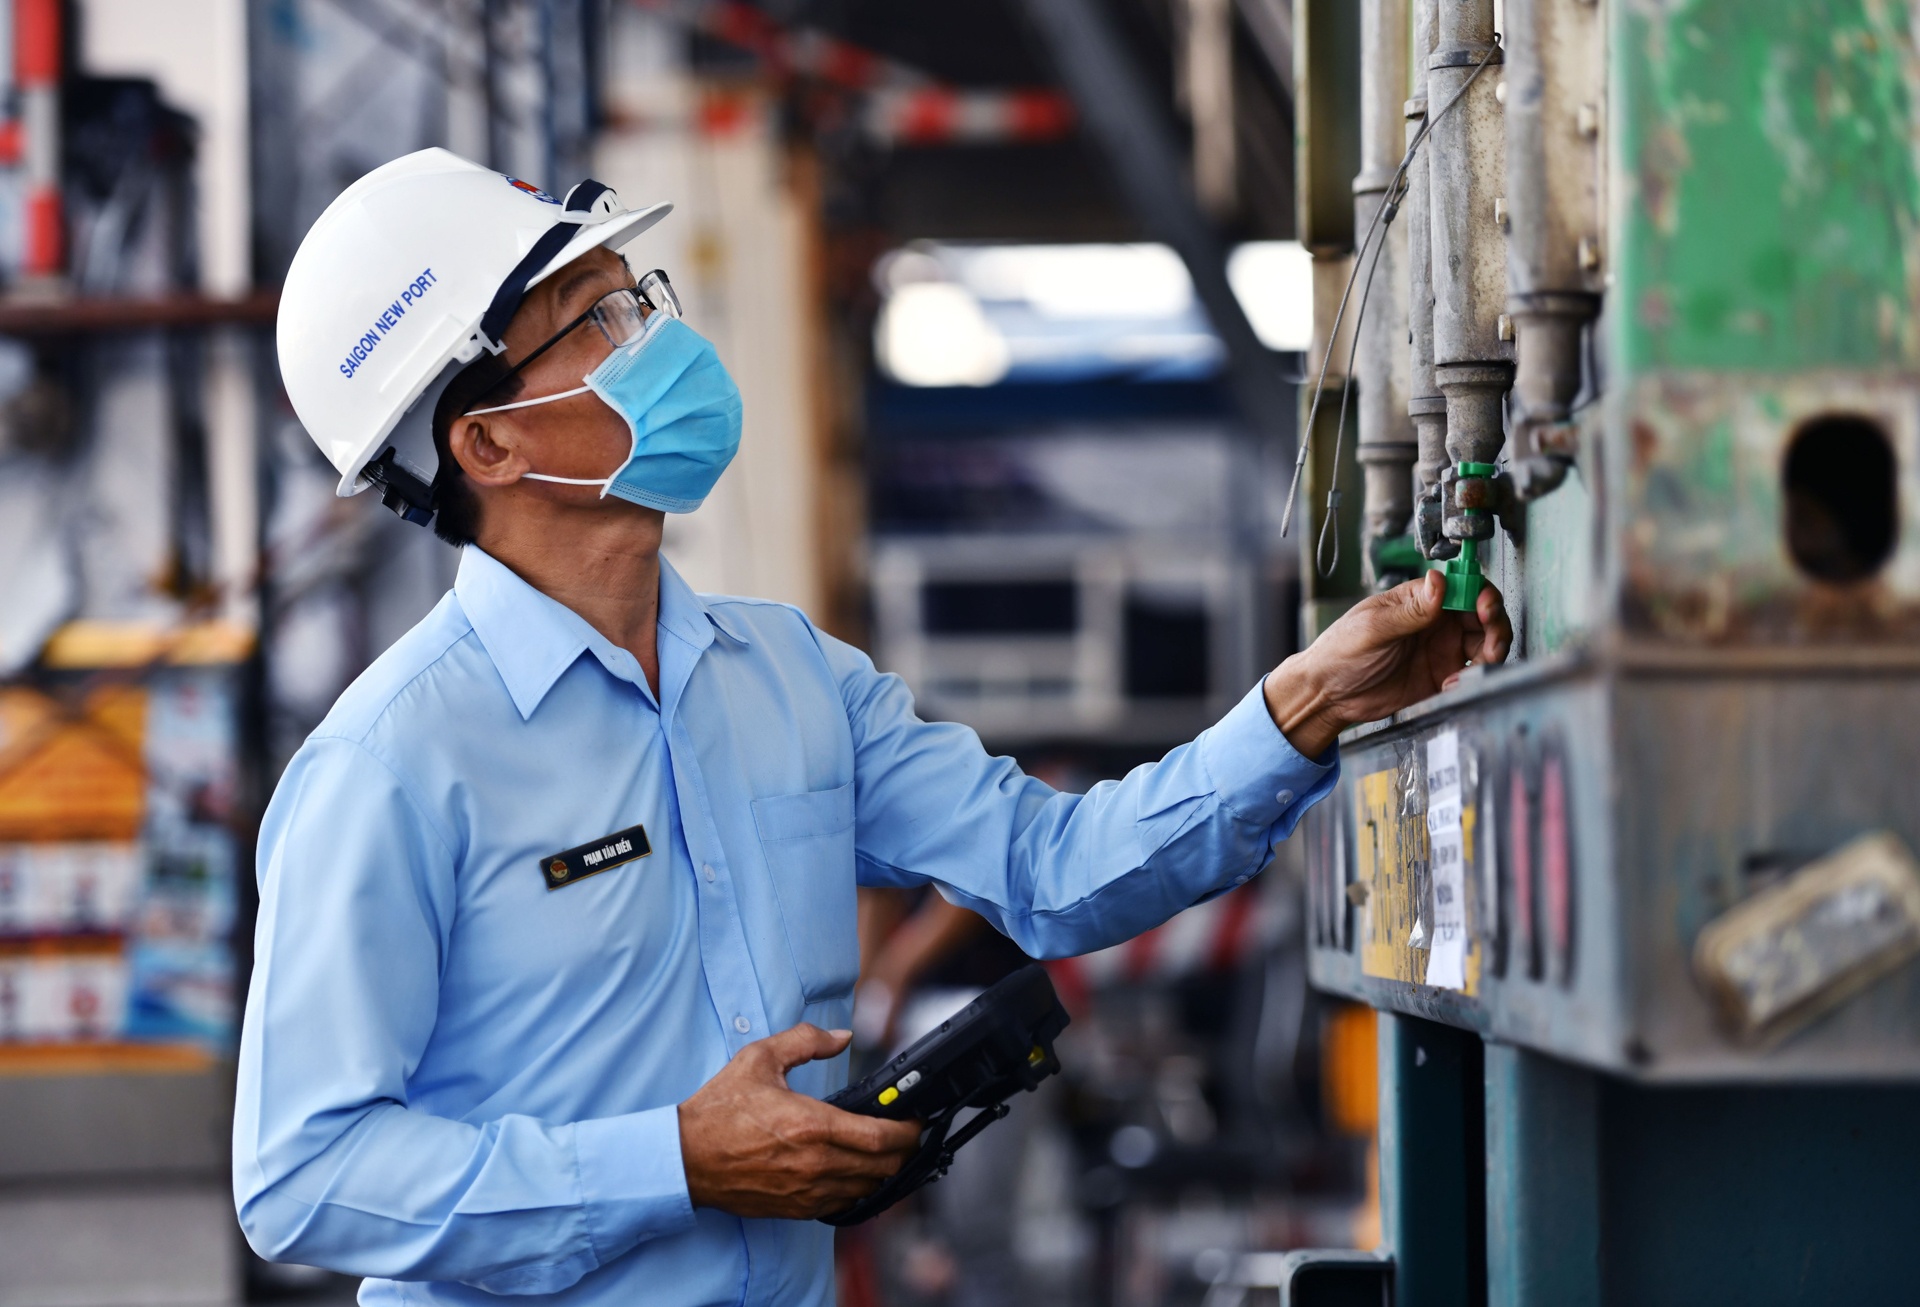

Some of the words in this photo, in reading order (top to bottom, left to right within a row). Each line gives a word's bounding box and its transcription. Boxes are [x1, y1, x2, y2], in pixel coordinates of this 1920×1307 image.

[340, 329, 381, 378] SAIGON
[375, 300, 405, 335] NEW
[401, 268, 437, 307] PORT
[583, 850, 603, 866] PHẠM
[602, 845, 616, 859] VĂN
